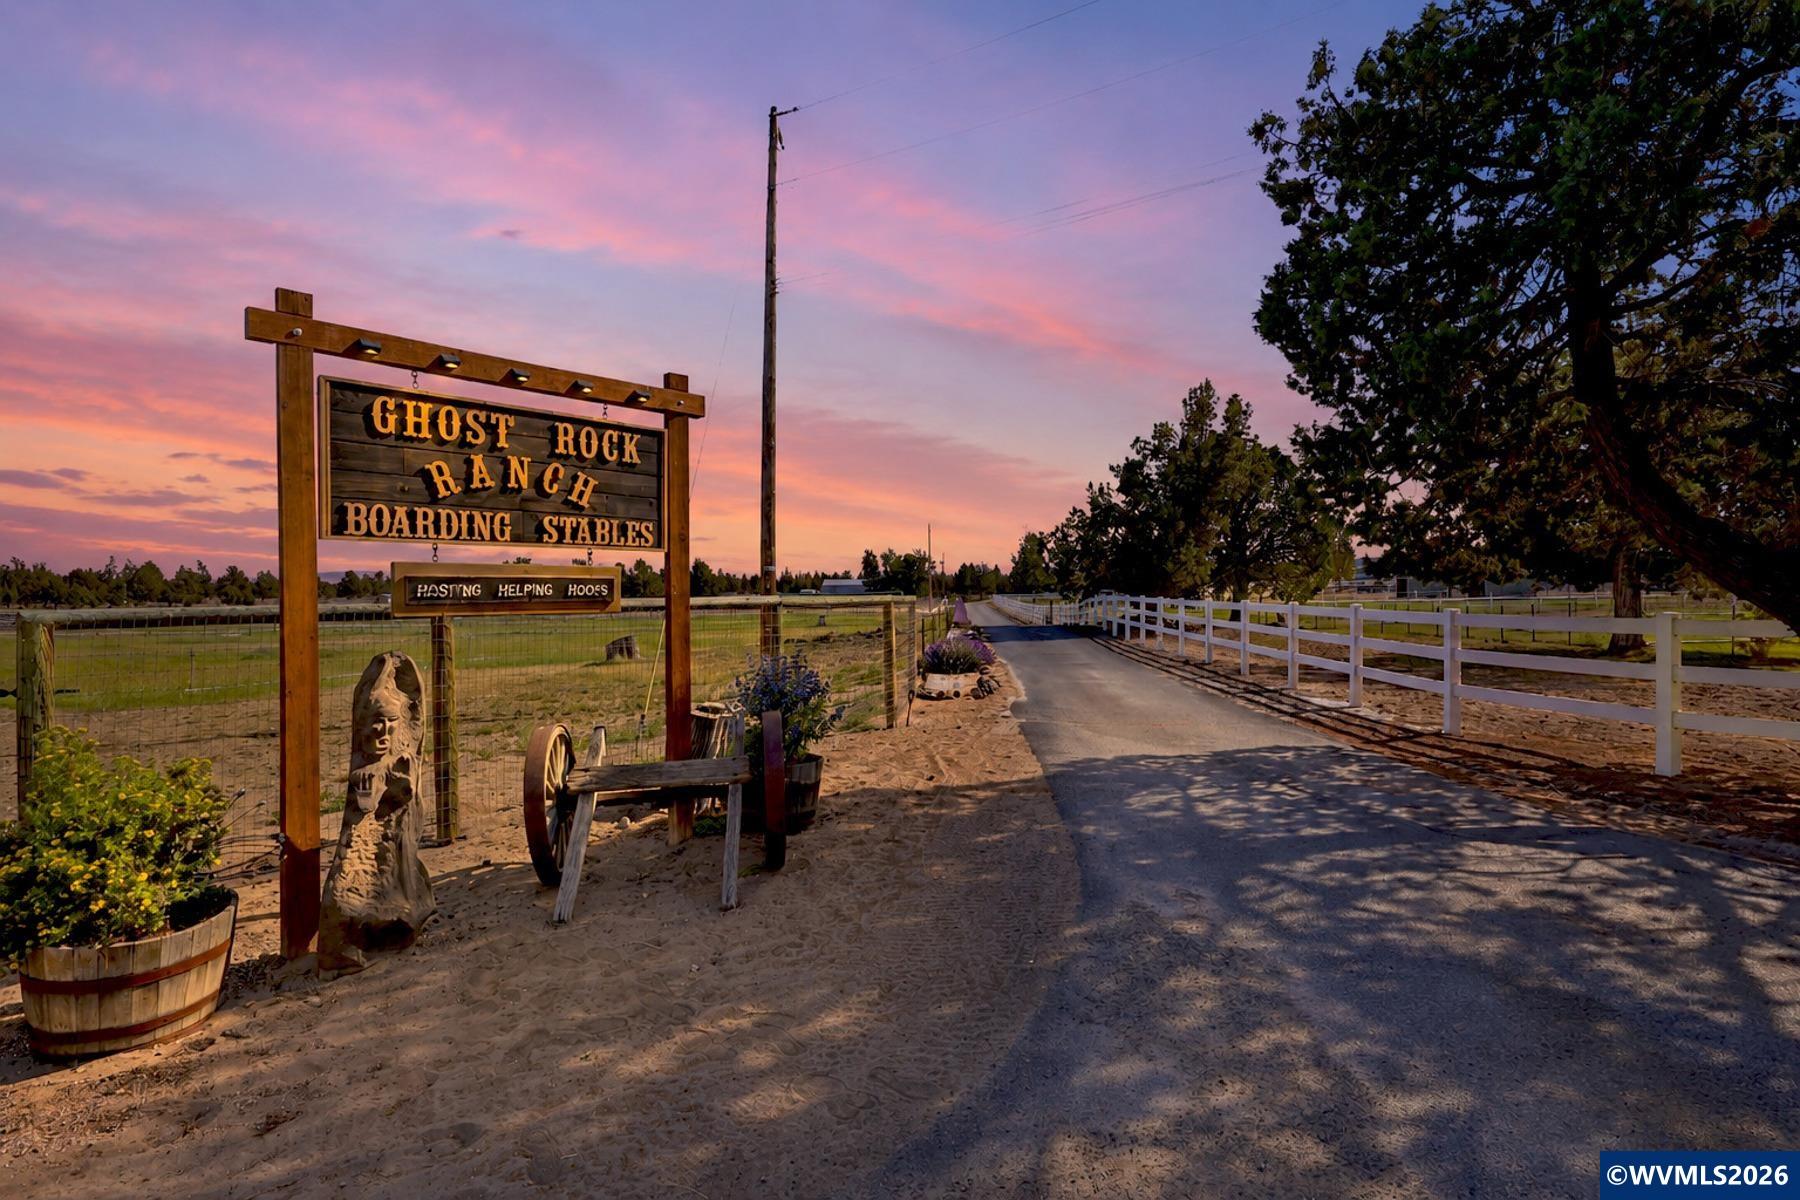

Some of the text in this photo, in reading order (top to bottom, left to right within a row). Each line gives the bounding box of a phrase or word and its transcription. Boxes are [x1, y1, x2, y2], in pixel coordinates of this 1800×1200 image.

[371, 396, 641, 464] GHOST ROCK
[425, 454, 599, 509] RANCH
[343, 502, 654, 547] BOARDING STABLES
[498, 583, 553, 596] HELPING
